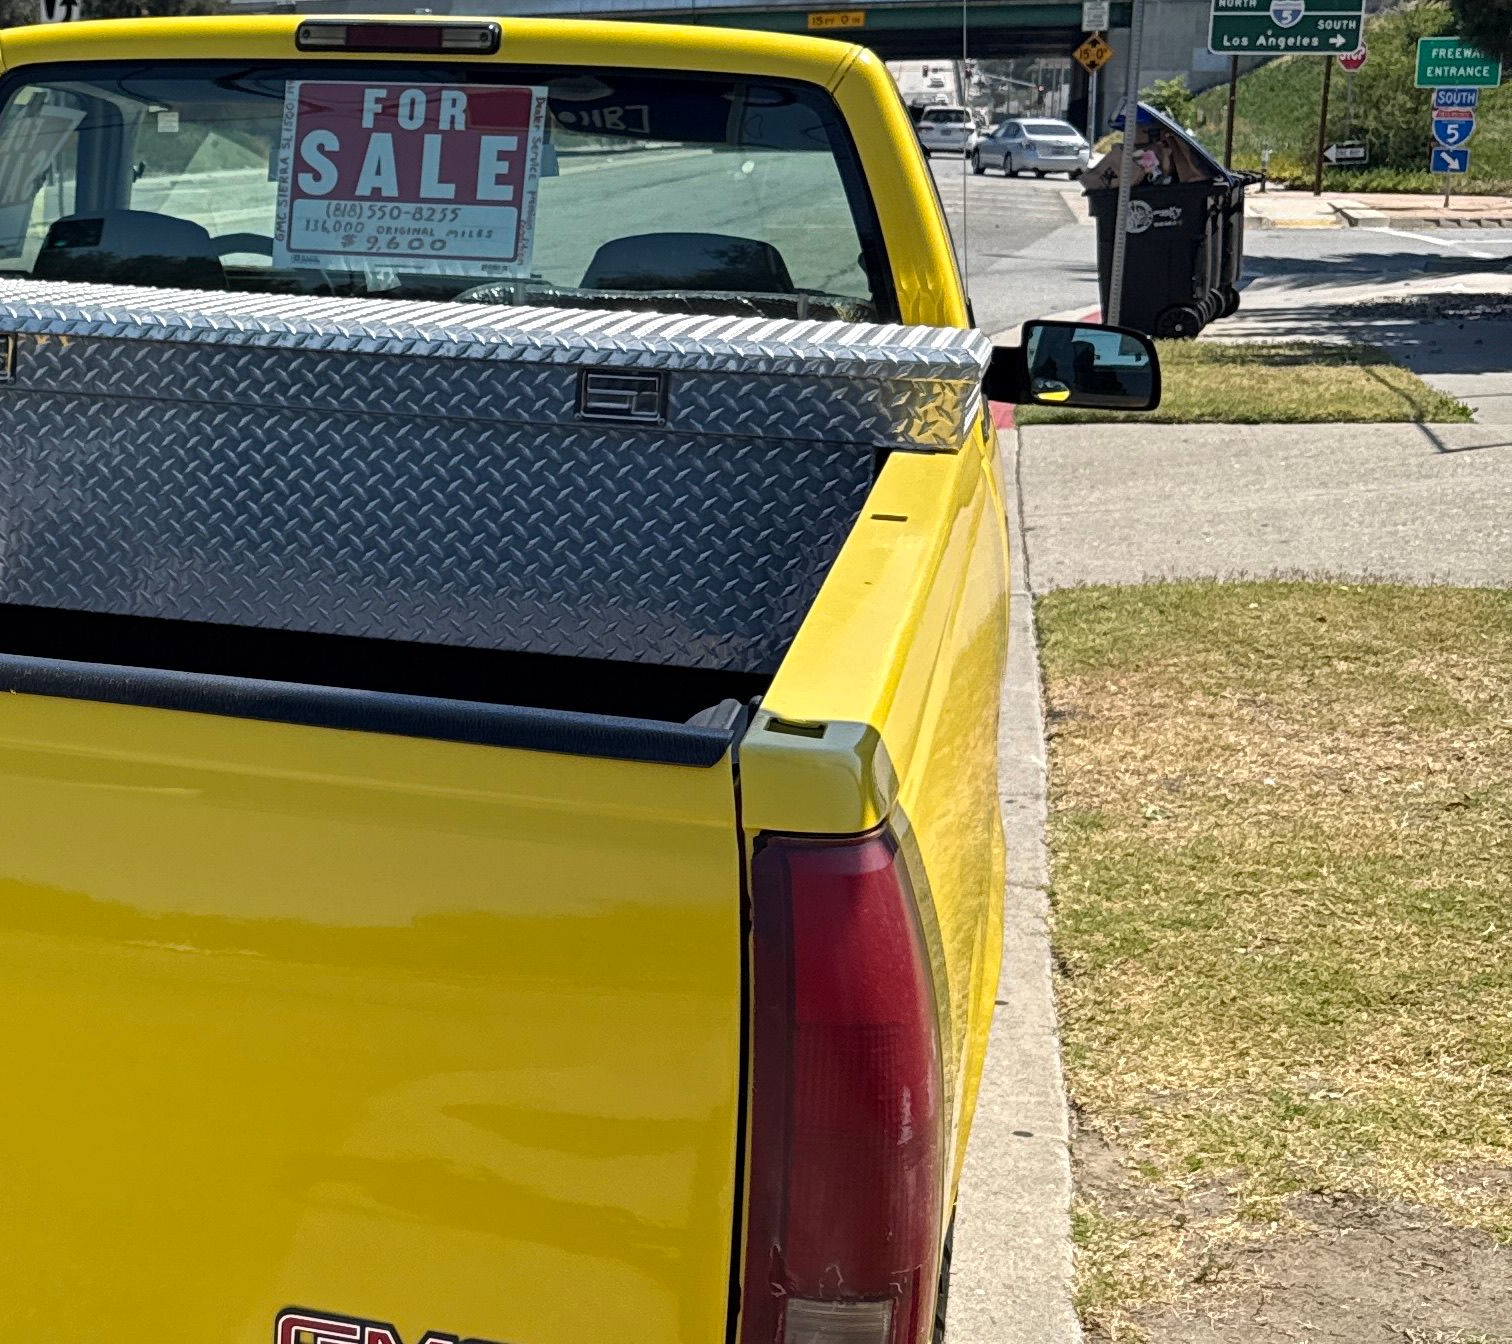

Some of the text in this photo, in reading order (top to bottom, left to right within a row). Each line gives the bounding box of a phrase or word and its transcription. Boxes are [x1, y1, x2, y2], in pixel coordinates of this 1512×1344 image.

[1282, 10, 1293, 24] 5
[1317, 19, 1357, 31] SOUTH
[1222, 34, 1319, 50] Los Angeles
[1426, 65, 1490, 78] ENTRANCE
[1437, 90, 1476, 105] SOUTH
[361, 88, 468, 131] FOR
[1446, 124, 1459, 143] 5
[298, 128, 519, 202] SALE
